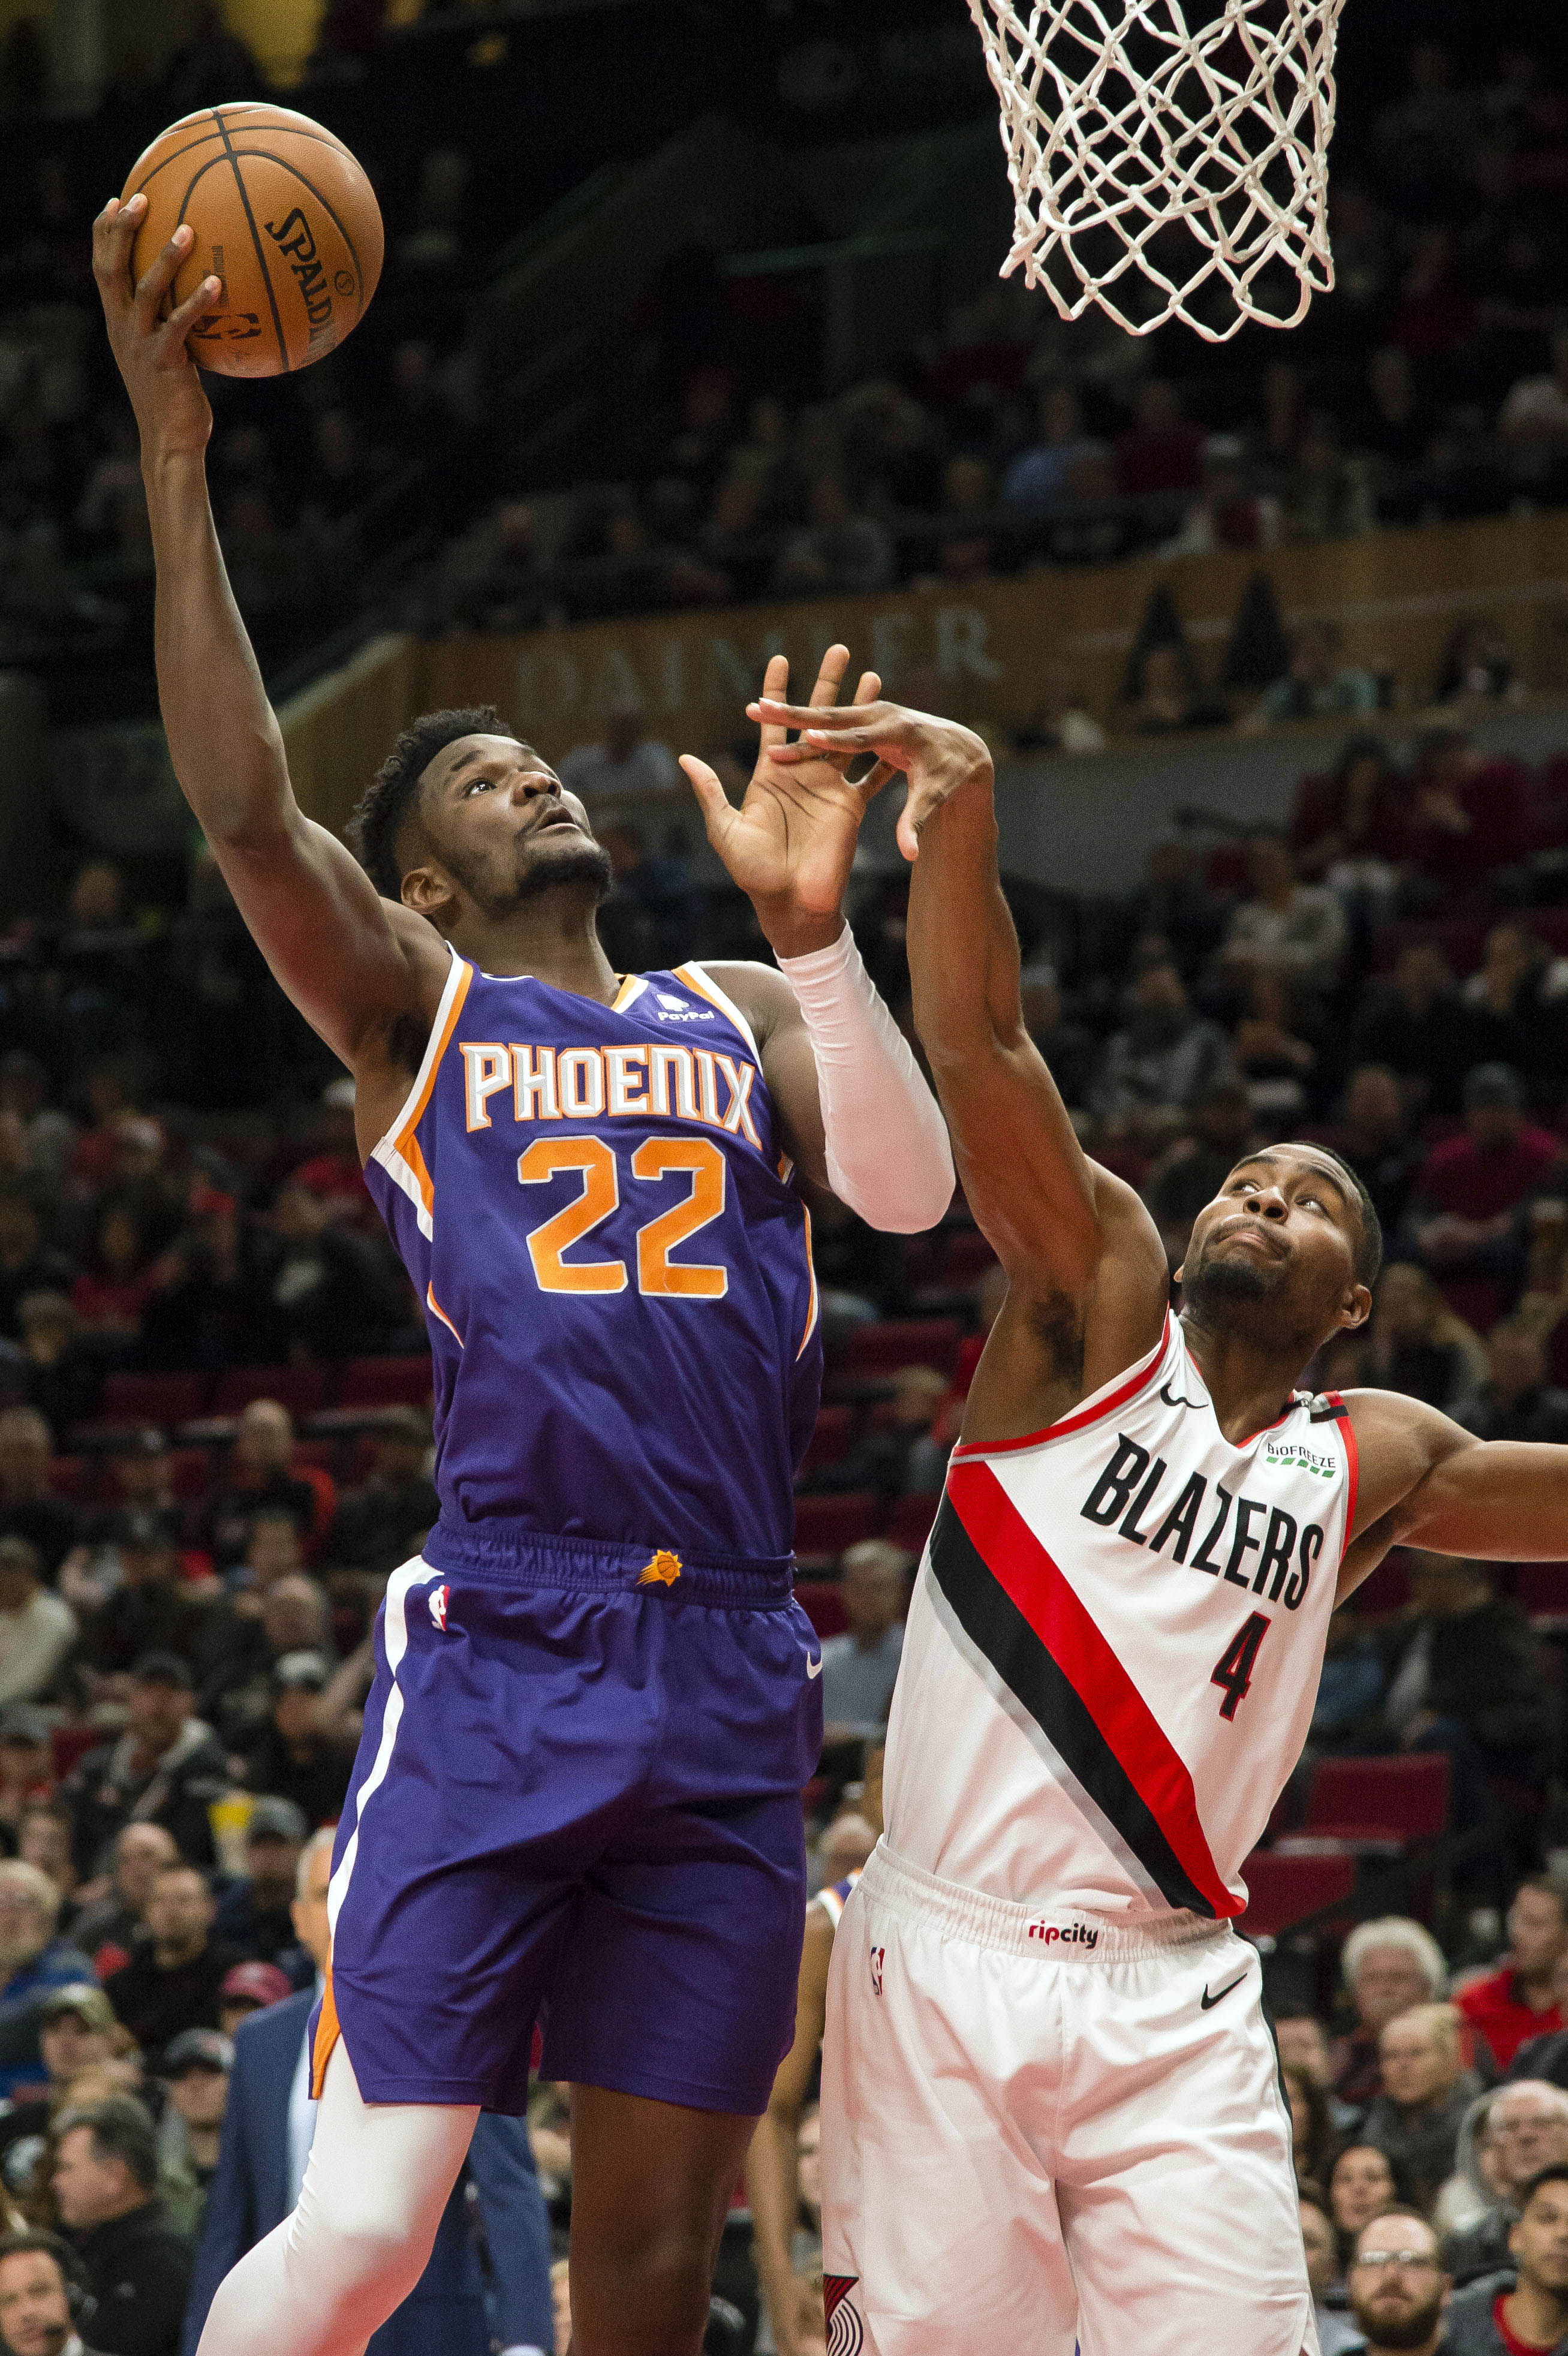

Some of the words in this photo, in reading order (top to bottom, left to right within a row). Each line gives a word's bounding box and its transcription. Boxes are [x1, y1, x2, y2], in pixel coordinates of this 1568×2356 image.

[657, 1010, 715, 1022] PayPal
[459, 1042, 763, 1151] PHOENIX
[517, 1135, 729, 1299] 22
[1080, 1432, 1325, 1611] BLAZERS
[1210, 1611, 1271, 1722] 4
[1028, 1919, 1098, 1949] ripcity
